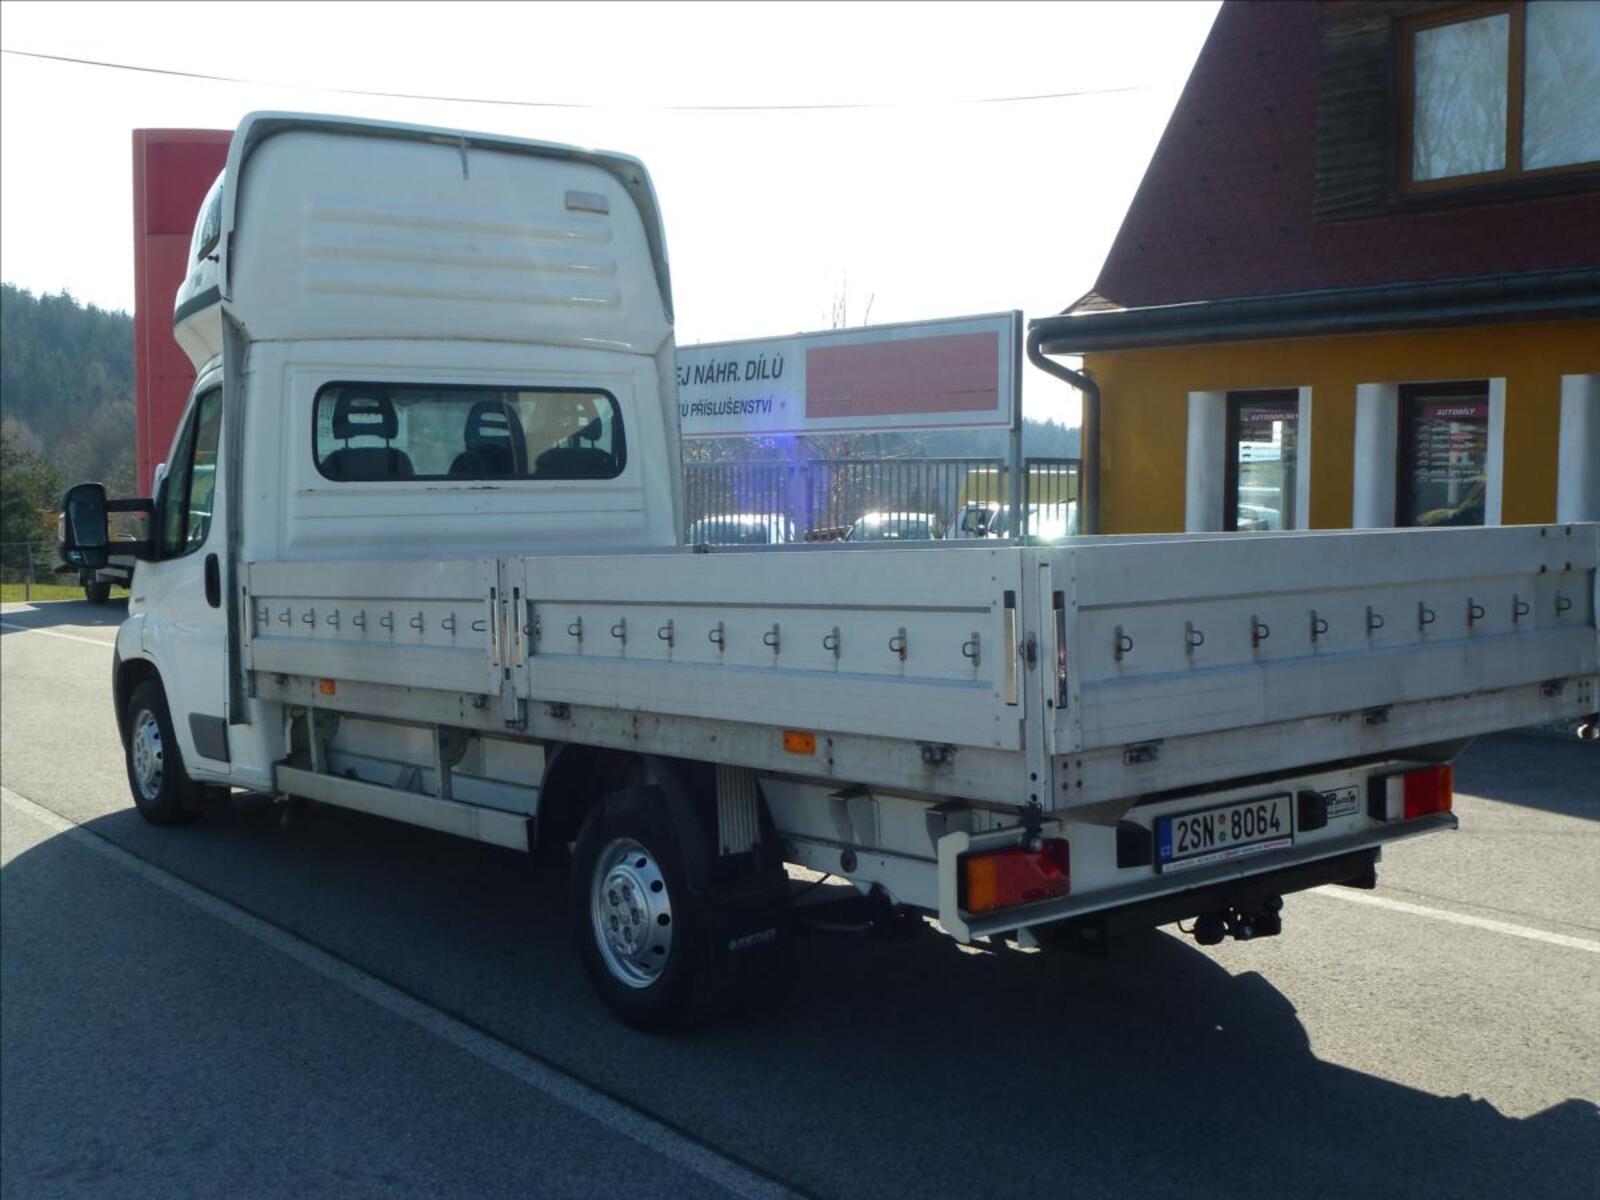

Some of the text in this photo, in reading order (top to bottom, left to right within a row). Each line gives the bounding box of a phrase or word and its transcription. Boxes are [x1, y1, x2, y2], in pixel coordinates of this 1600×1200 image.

[694, 359, 741, 385] NÁHR.
[745, 352, 784, 381] DÍLŮ
[690, 395, 774, 416] PŘÍSLUŠENSTVÍ
[1177, 802, 1281, 853] 2SN 8064
